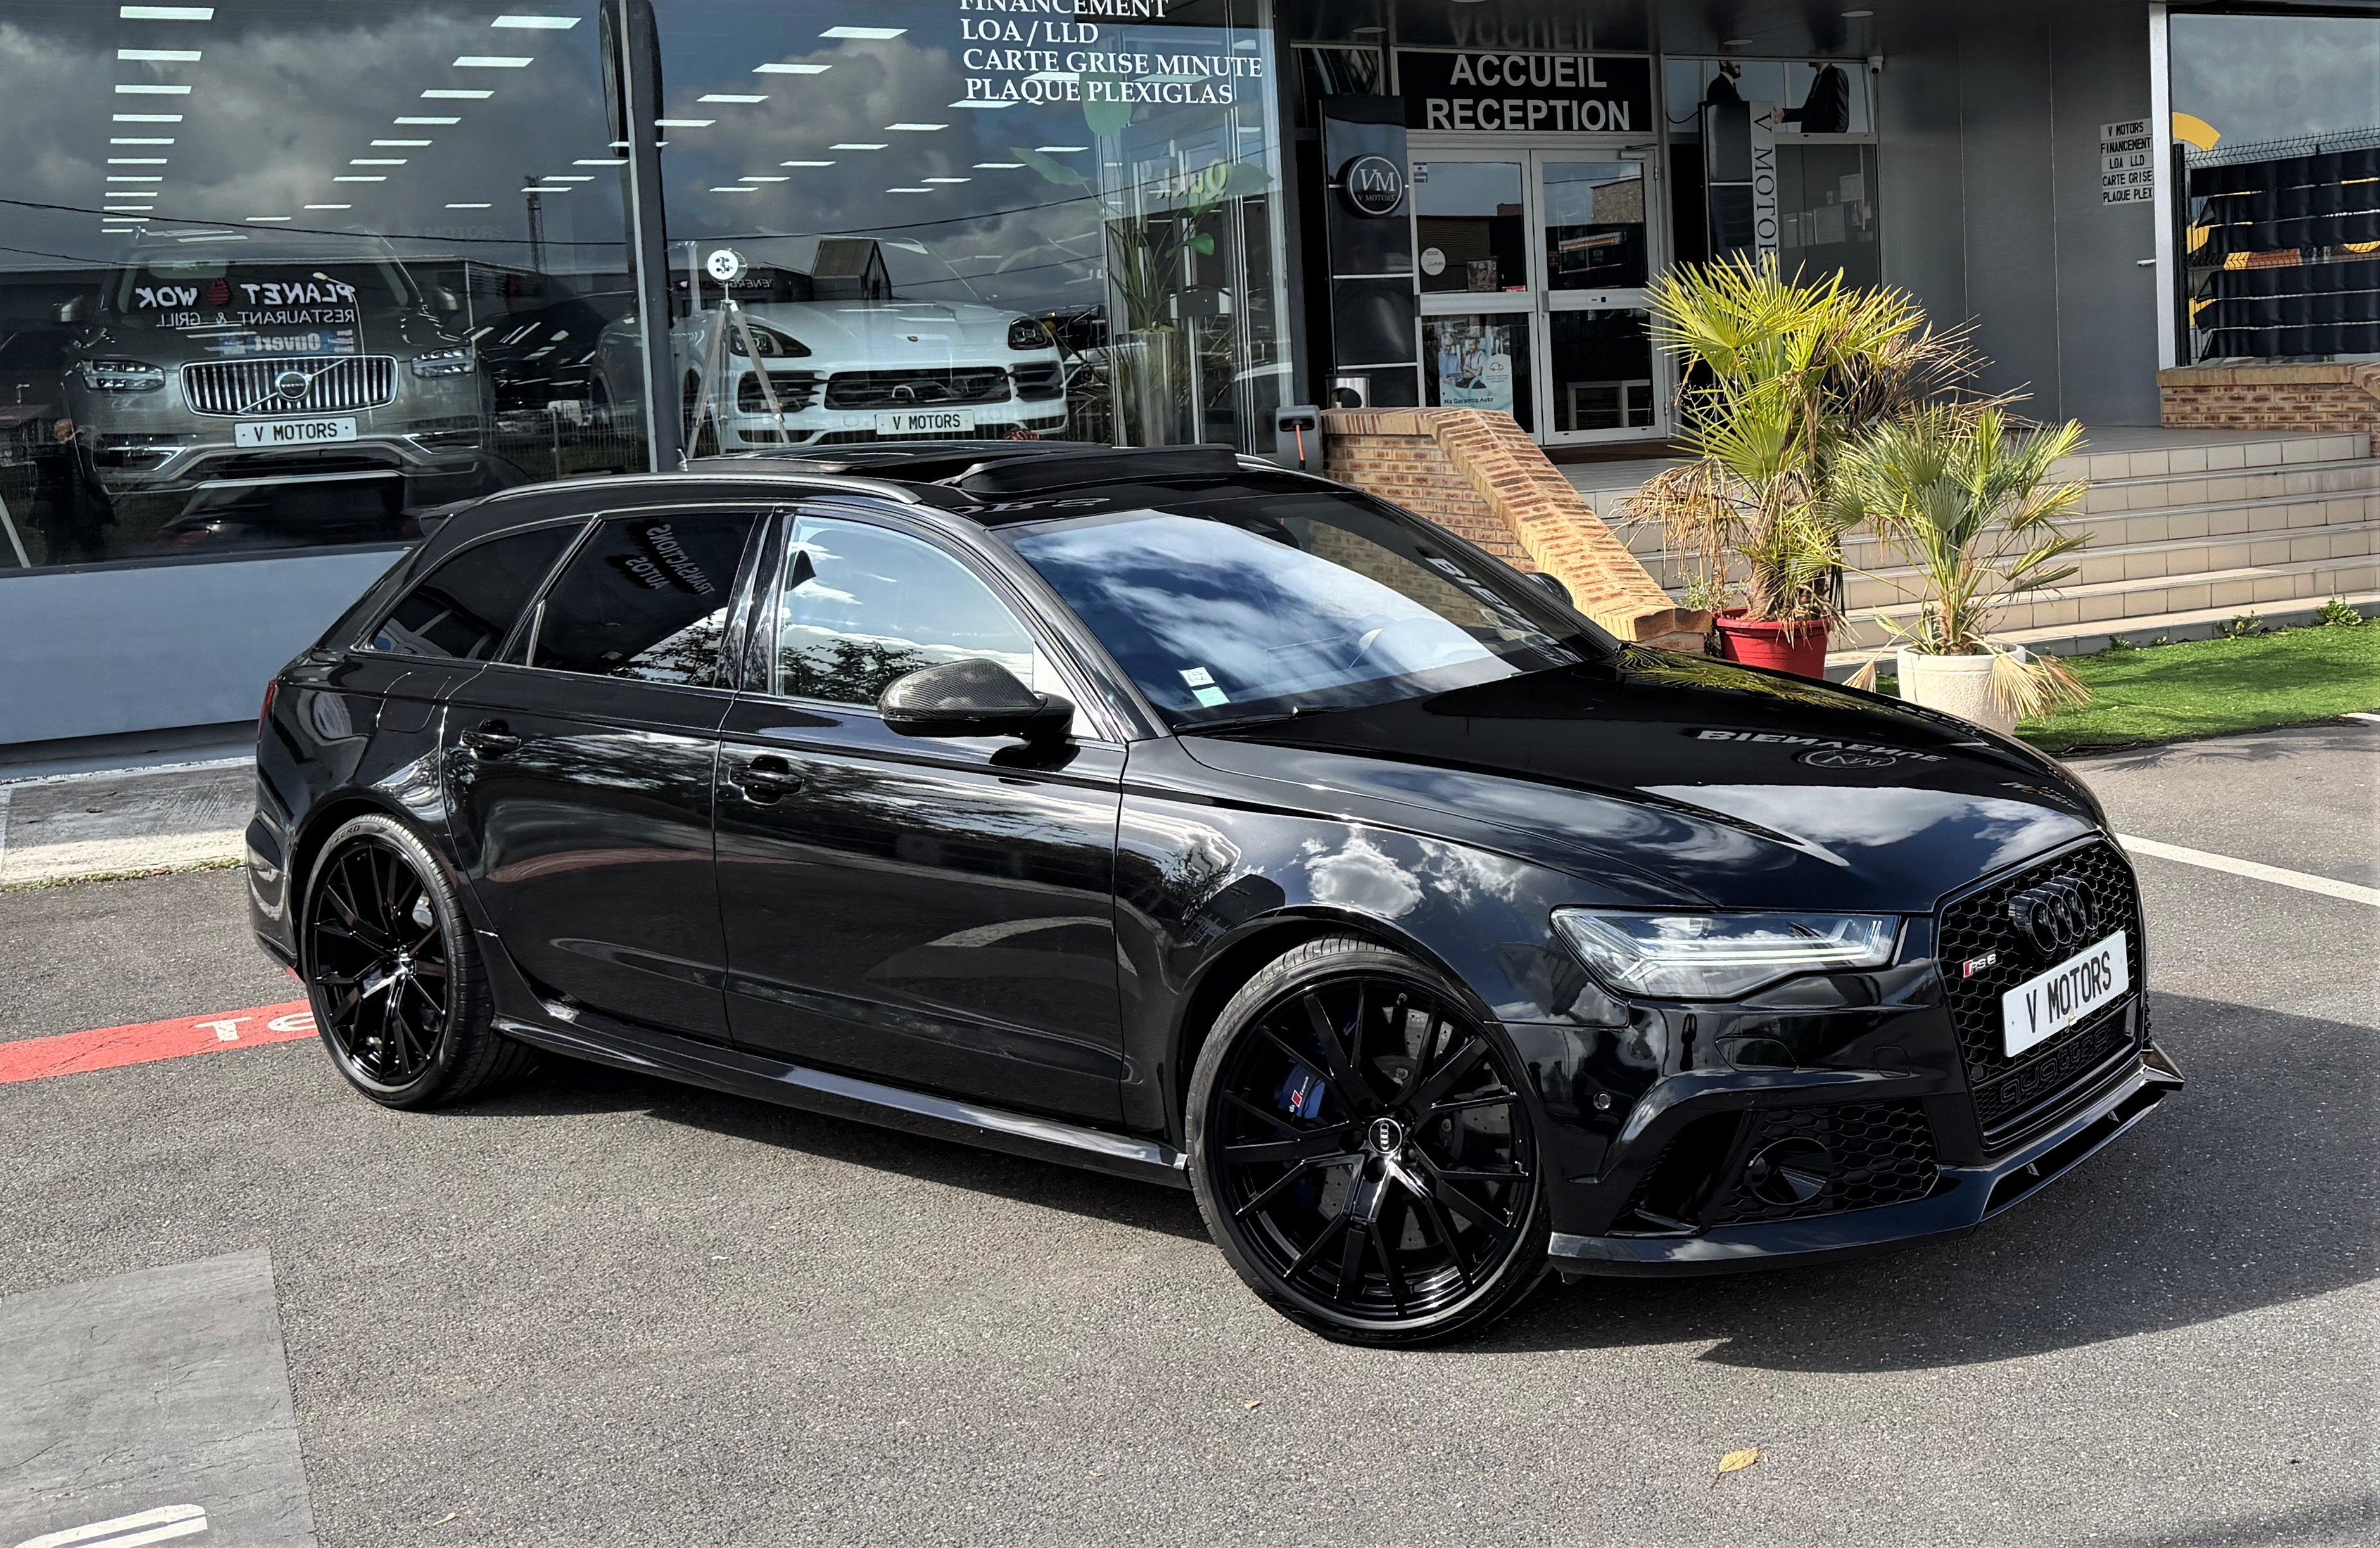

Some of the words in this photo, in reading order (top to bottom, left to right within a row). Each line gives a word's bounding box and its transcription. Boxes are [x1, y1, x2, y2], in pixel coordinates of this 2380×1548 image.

[963, 48, 1059, 73] CARTE
[1067, 51, 1148, 75] GRISE
[1155, 54, 1263, 77] MINUTE
[1450, 54, 1607, 88] ACCUEIL
[966, 78, 1080, 106] PLAQUE
[1088, 81, 1234, 105] PLEXIGLAS
[1426, 98, 1630, 131] RECEPTION
[1753, 112, 1773, 133] V
[2108, 125, 2113, 137] V
[2116, 122, 2144, 137] MOTORS
[2101, 137, 2151, 155] FINANCEMENT
[2110, 156, 2124, 170] LOA
[2130, 155, 2144, 167] LLD
[1359, 168, 1396, 191] VM
[2103, 173, 2125, 187] CARTE
[2129, 170, 2153, 183] GRISE
[2103, 189, 2130, 203] PLAQUE
[2134, 187, 2153, 200] PLEX
[254, 426, 263, 442] V
[273, 422, 338, 441] MOTORS
[893, 416, 901, 430] V
[909, 414, 961, 430] MOTORS
[2026, 989, 2037, 1034] V
[2046, 950, 2112, 1025] MOTORS
